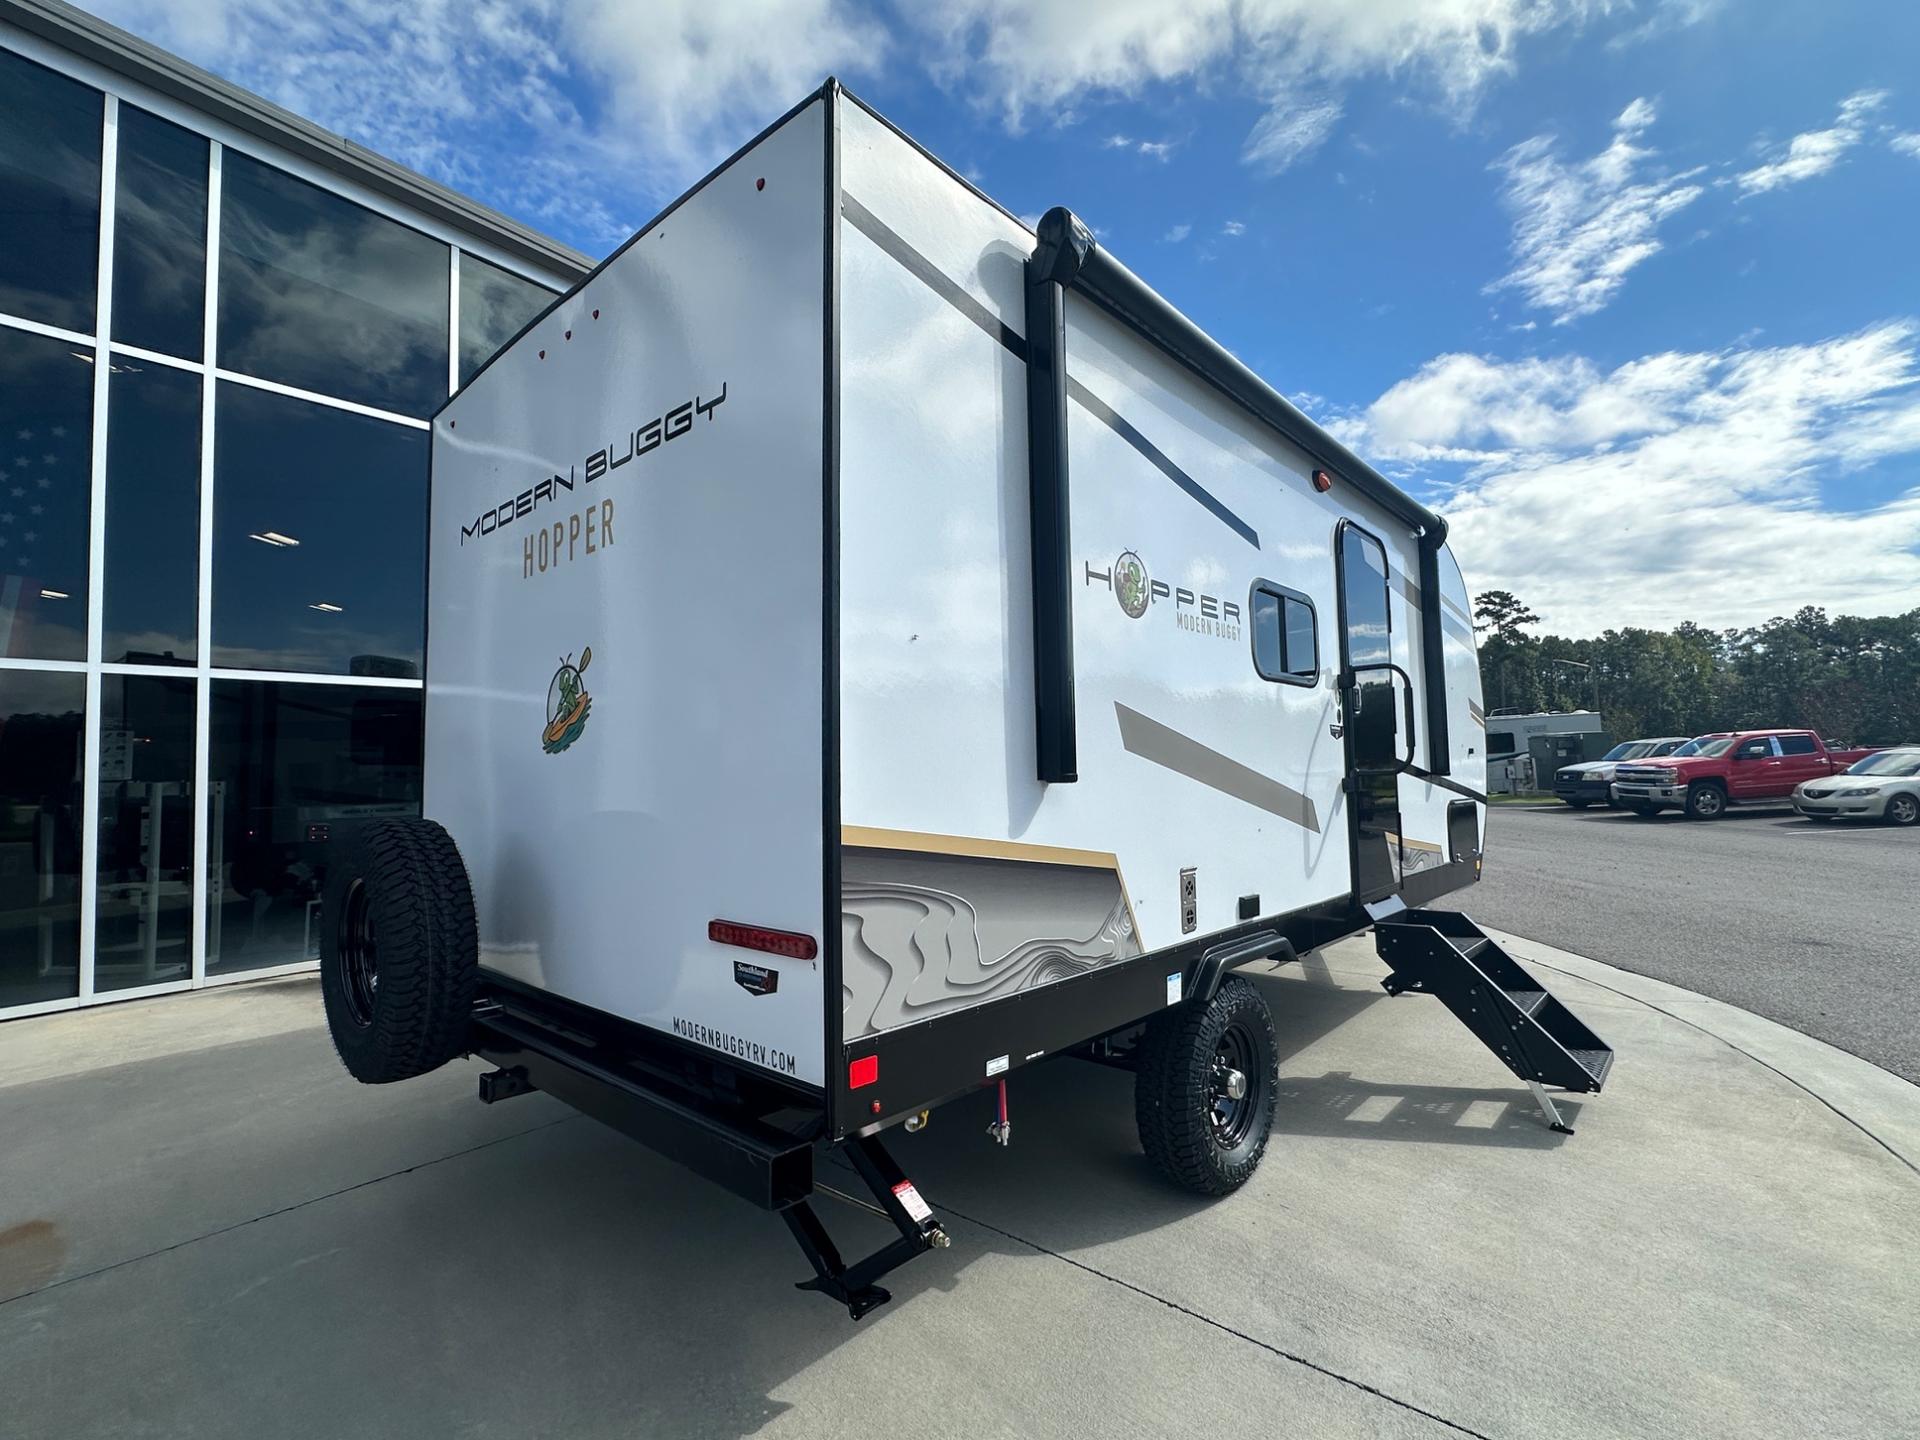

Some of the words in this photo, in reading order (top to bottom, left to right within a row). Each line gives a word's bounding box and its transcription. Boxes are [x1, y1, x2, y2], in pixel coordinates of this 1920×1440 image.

[460, 465, 574, 547] MODERN
[585, 381, 727, 484] BUGGY
[523, 498, 614, 579] HOPPER
[1085, 551, 1241, 625] HOPPER
[1176, 611, 1212, 636] MODERN
[1215, 621, 1241, 642] BUGGY
[673, 1016, 796, 1075] MODERNBUGGYRV.COM
